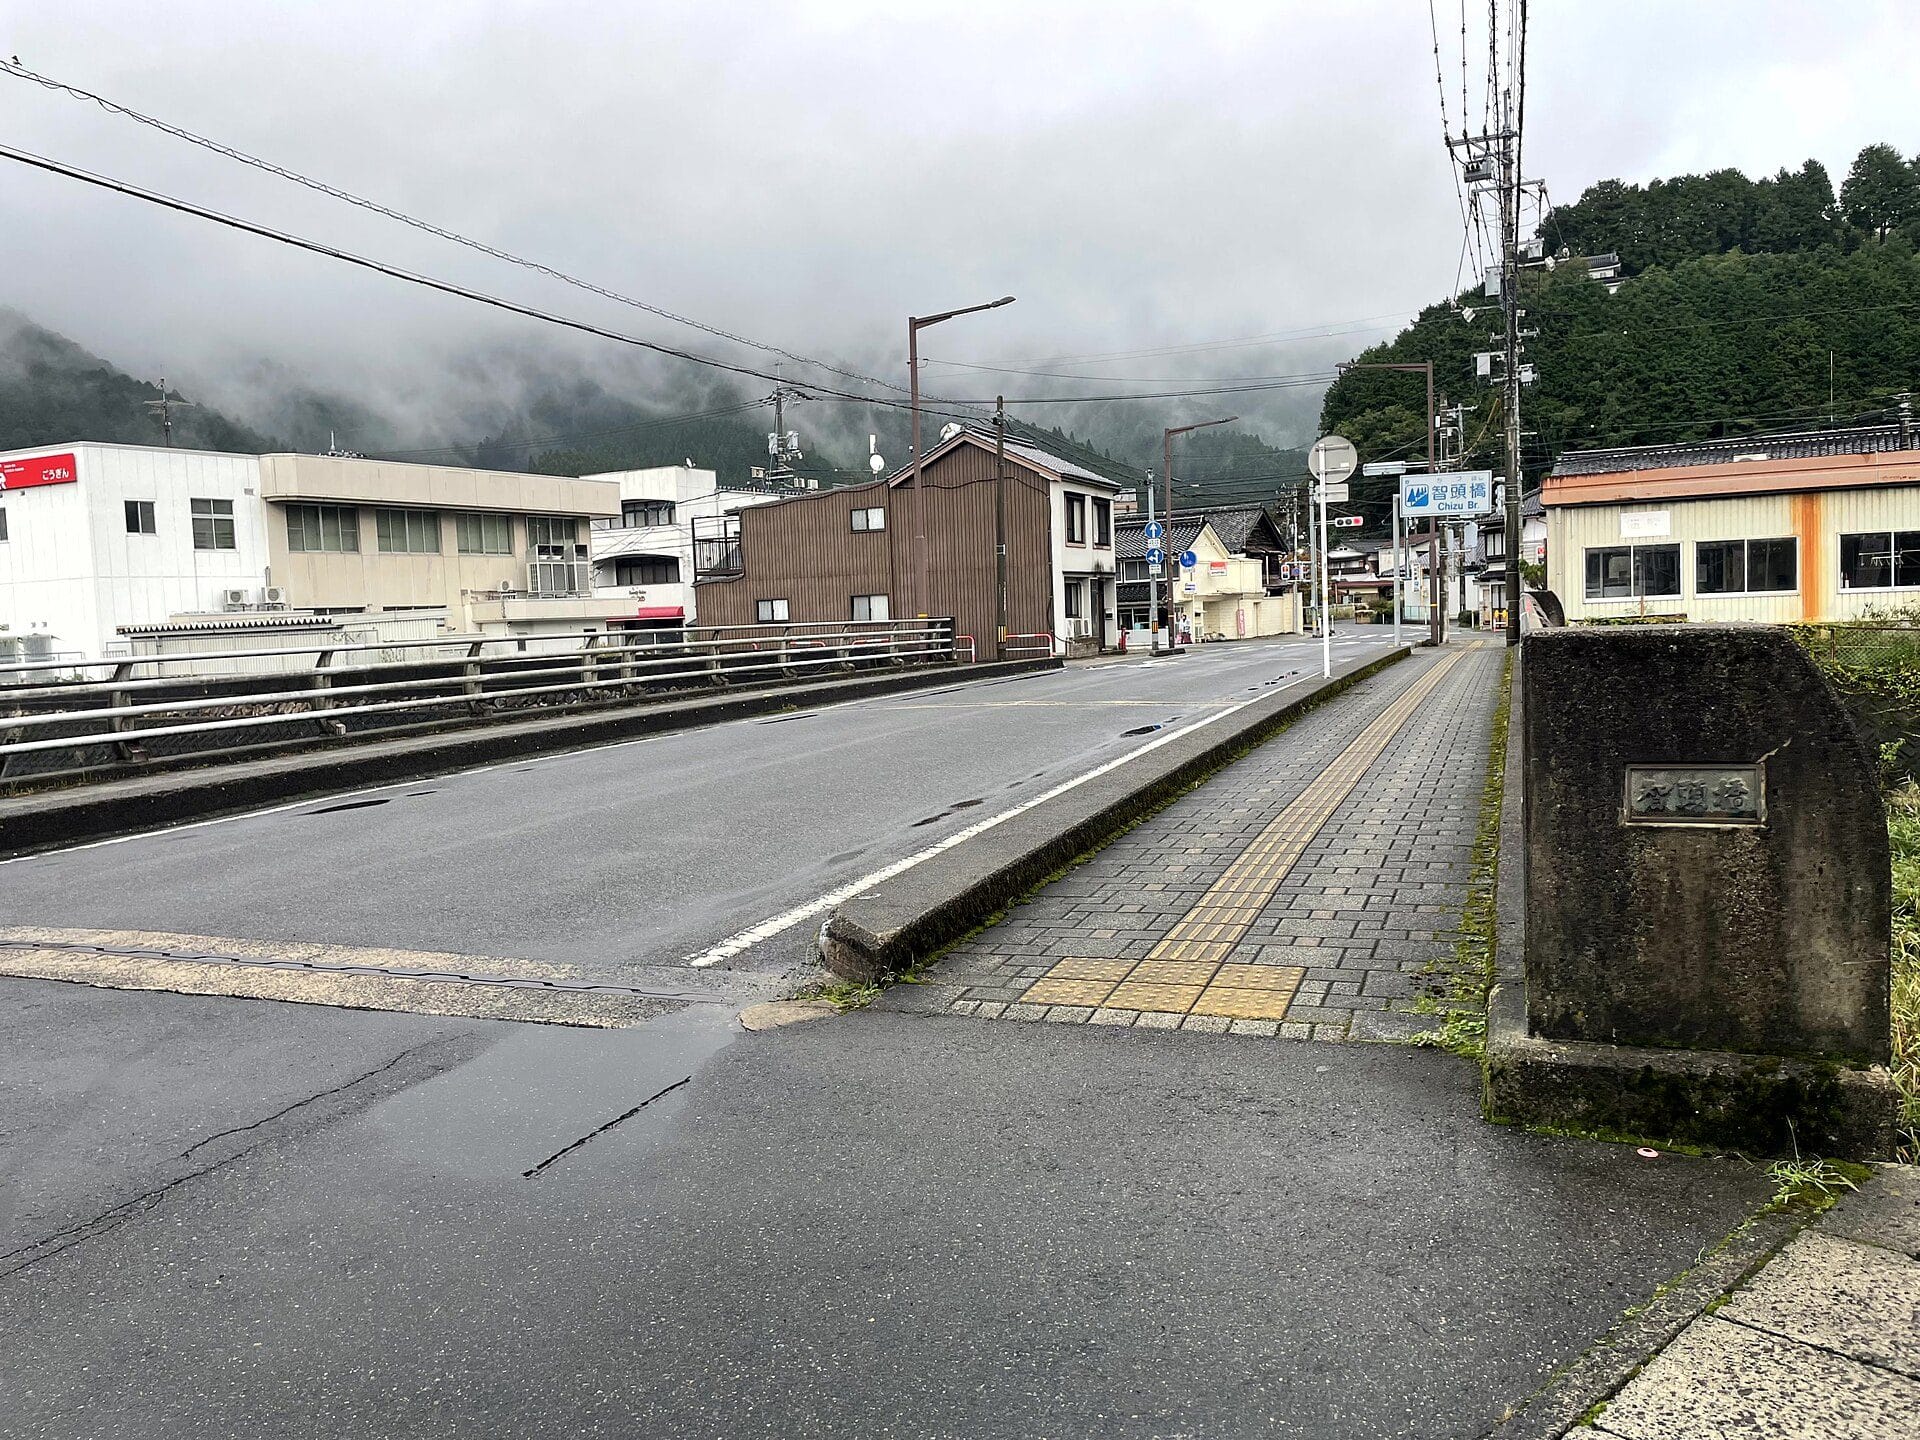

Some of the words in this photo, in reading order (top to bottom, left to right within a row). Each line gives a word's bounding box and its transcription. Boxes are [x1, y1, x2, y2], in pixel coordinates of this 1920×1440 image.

[42, 468, 70, 480] ごうぎん
[1432, 483, 1486, 501] 智頭橋
[1437, 501, 1464, 511] Chizu
